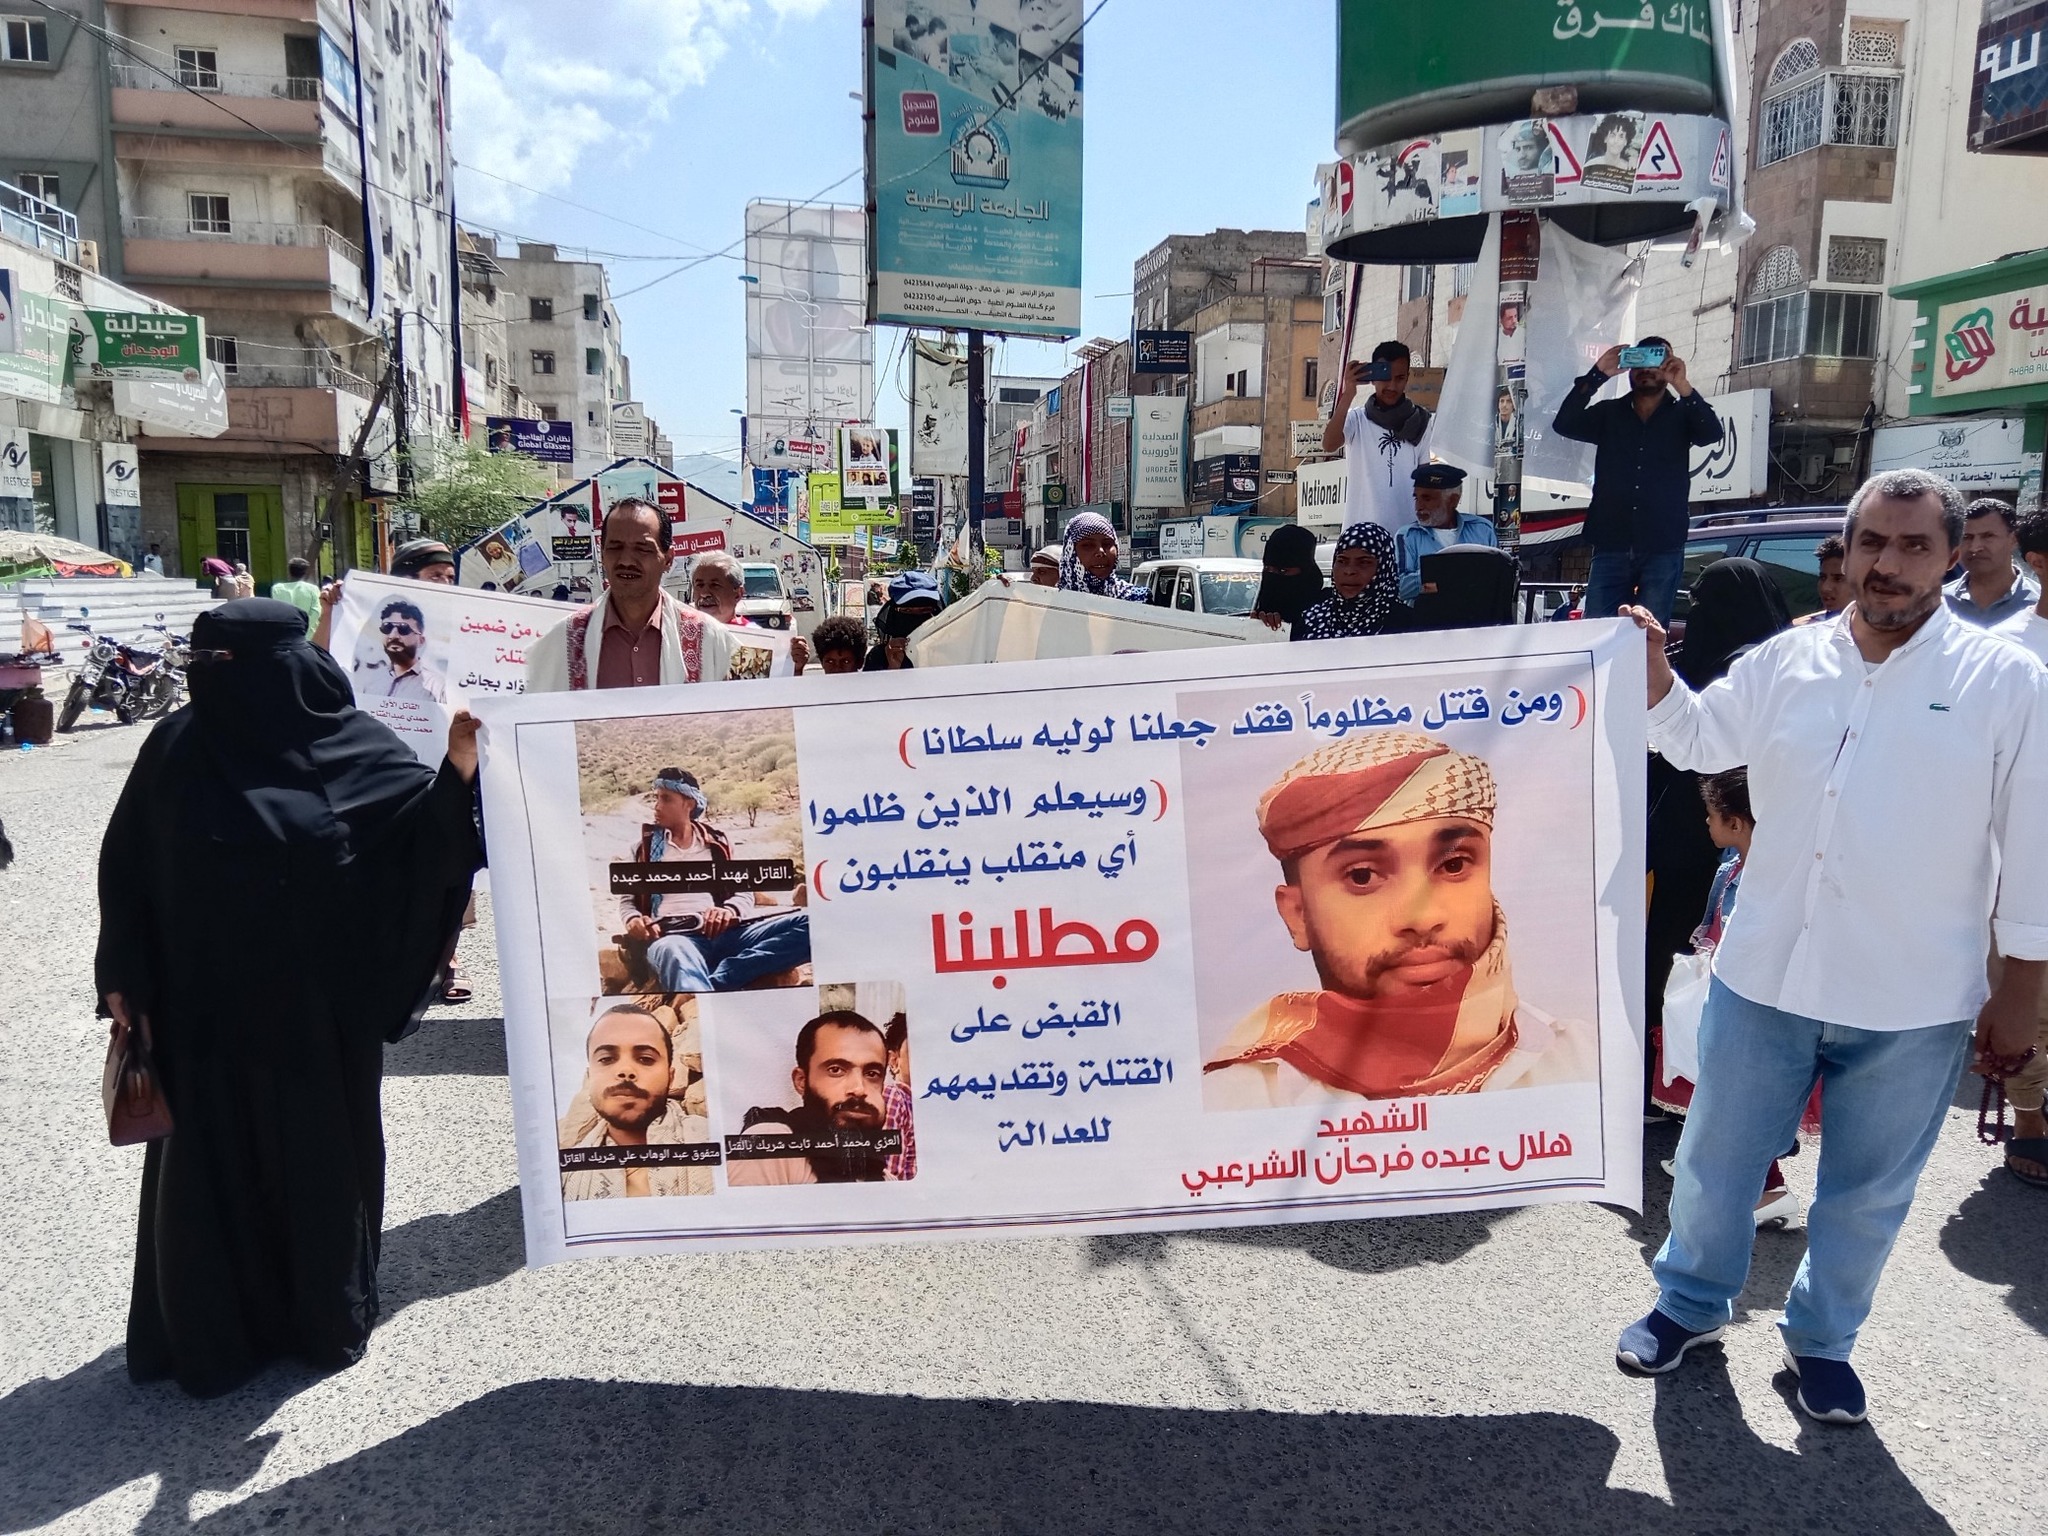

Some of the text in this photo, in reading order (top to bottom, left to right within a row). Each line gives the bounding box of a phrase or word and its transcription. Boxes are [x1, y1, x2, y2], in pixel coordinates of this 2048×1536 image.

[903, 98, 936, 111] التسجيل
[907, 115, 936, 128] مفتوح
[905, 188, 1050, 223] الجامعة الوطنية
[104, 313, 188, 340] صيدلية
[121, 343, 180, 361] الوجدان
[517, 440, 571, 451] Global Glasses
[1141, 431, 1179, 443] الصيدلية
[1141, 444, 1179, 458] الأوروبية
[1926, 462, 1945, 470] تعز
[1959, 471, 1997, 487] الخدمة
[1301, 477, 1342, 507] National
[1699, 483, 1732, 495] فرع تعز
[690, 536, 721, 551] افتهان
[460, 616, 507, 634] ضمين
[510, 623, 532, 639] من
[495, 647, 528, 666] تلة
[458, 672, 526, 695] ؤاد بجاش
[1231, 702, 1294, 738] فقد
[1423, 688, 1488, 735] قتل
[1031, 715, 1115, 760] لوليه
[1130, 712, 1218, 749] جعلنا
[923, 724, 1023, 758] سلطانا
[808, 790, 906, 835] ظلموا
[916, 784, 1012, 830] الذين
[981, 839, 1087, 884] منقلب
[1097, 829, 1137, 880] أي
[611, 871, 642, 886] عبده
[645, 872, 682, 883] محمد
[685, 863, 717, 882] أحمد
[720, 870, 750, 884] مهند
[839, 845, 972, 894] ينقلبون
[931, 905, 1160, 991] مطلبنا
[950, 999, 1122, 1043] القبض على
[919, 1056, 1175, 1102] القتلة وتقديمهم
[1316, 1101, 1429, 1143] الشهيد
[814, 1134, 839, 1149] أحمد
[842, 1139, 871, 1149] محمد
[998, 1115, 1112, 1154] للعدالة
[725, 1140, 752, 1156] بالقتل
[755, 1139, 786, 1152] شريك
[560, 1148, 720, 1167] متفوق عبد الوهاب علي شريك القاتل
[1181, 1130, 1573, 1198] هلال عبده فرحان الشرعبي
